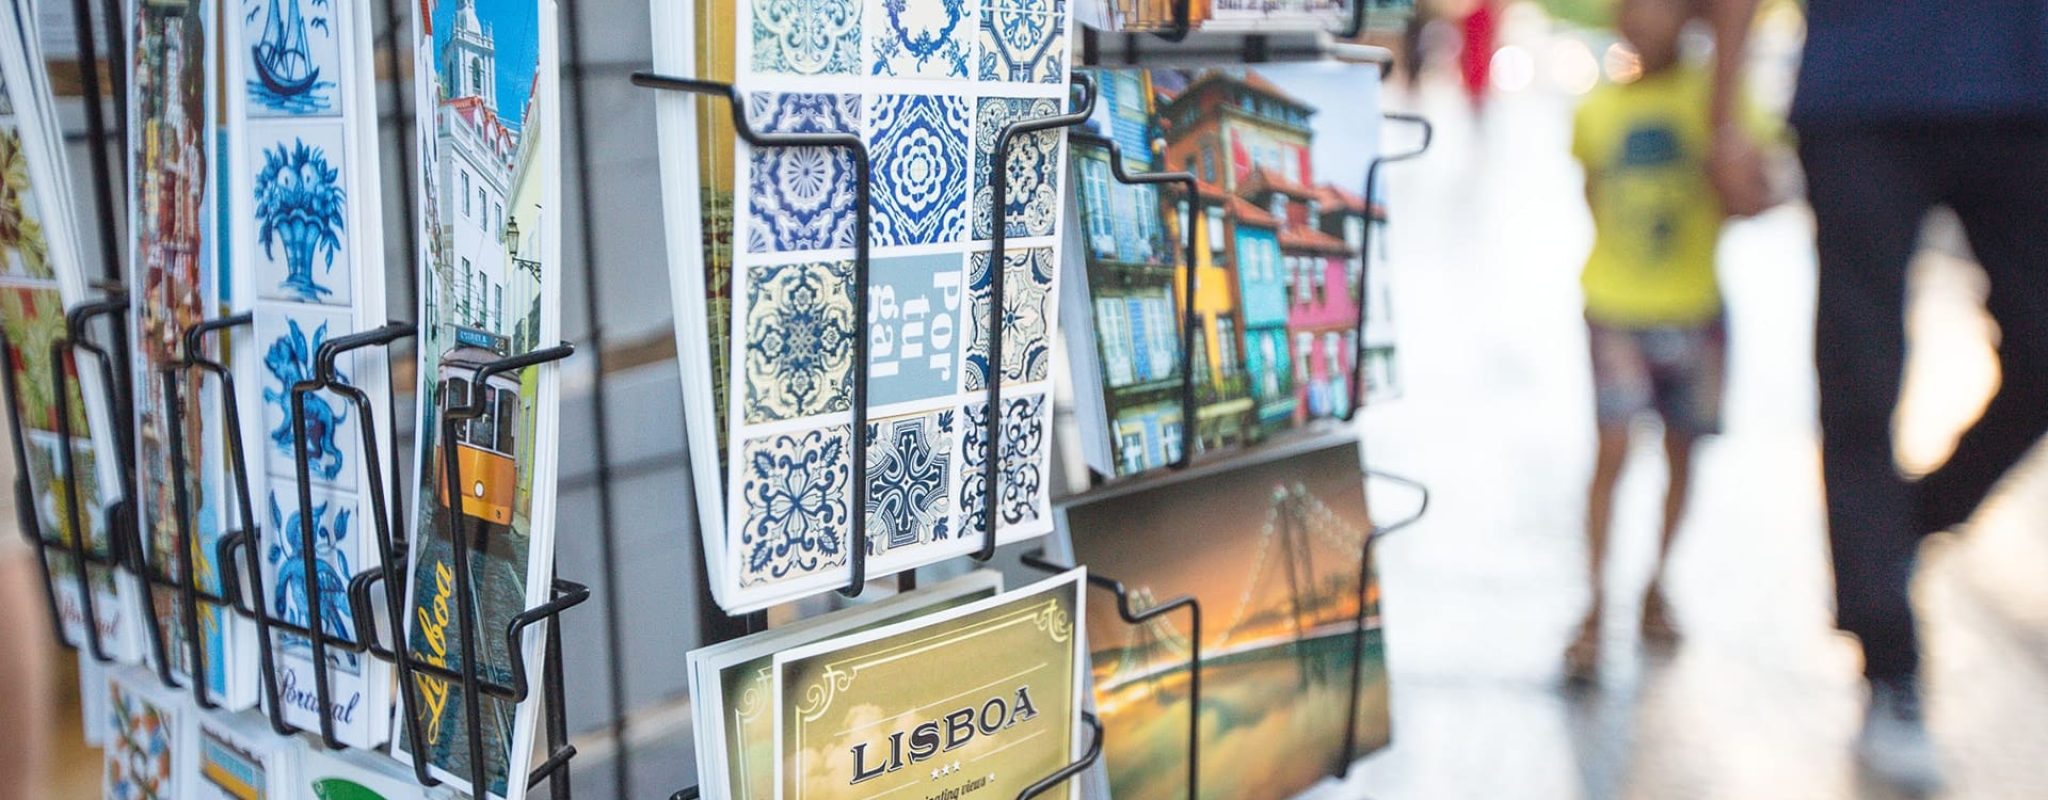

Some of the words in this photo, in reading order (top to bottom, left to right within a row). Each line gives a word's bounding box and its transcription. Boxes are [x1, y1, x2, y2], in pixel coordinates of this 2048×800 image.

[868, 284, 899, 378] gal
[901, 294, 931, 359] tu
[930, 271, 962, 381] Por
[278, 668, 360, 724] Portual
[415, 559, 452, 745] Lisboa
[850, 686, 1038, 785] LISBOA
[961, 776, 987, 796] views
